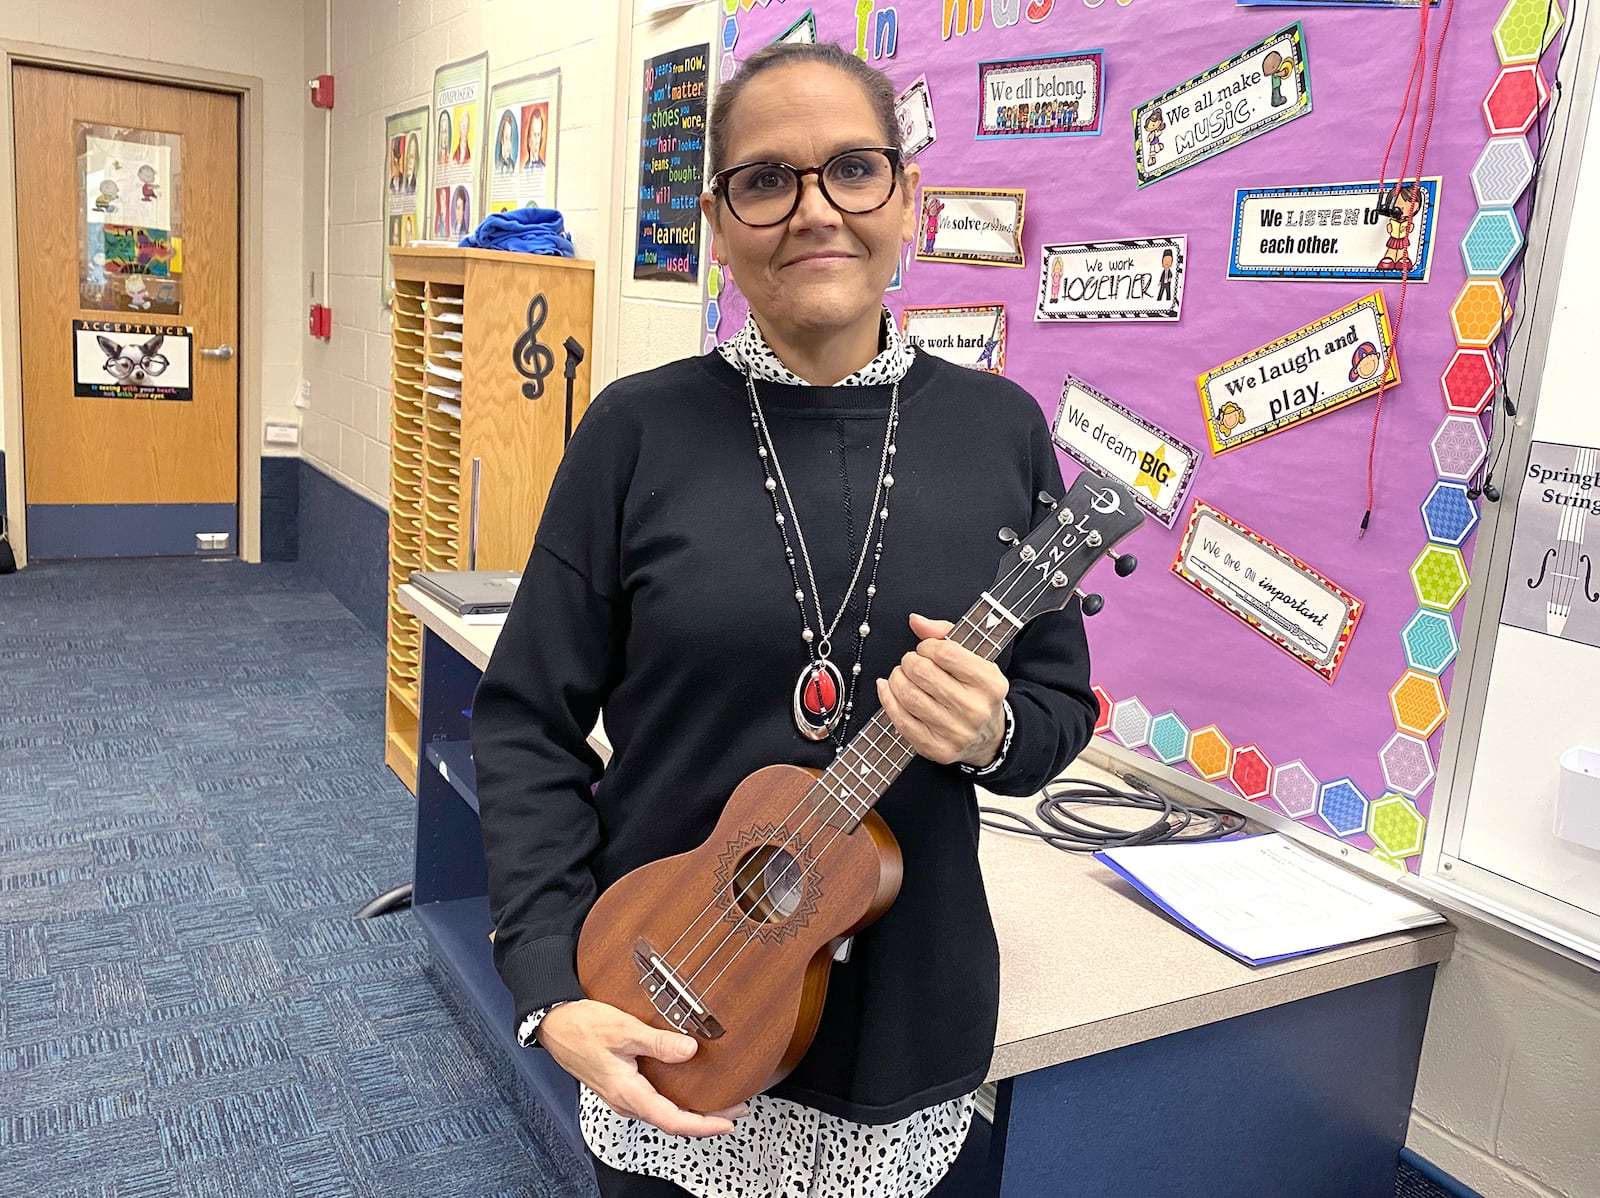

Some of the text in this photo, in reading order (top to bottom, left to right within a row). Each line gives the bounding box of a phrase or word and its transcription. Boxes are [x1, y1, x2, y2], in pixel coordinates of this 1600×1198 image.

[853, 0, 897, 60] In
[644, 67, 654, 92] 30
[654, 62, 673, 80] years
[684, 55, 706, 73] now,
[439, 85, 475, 106] COMPOSERS
[653, 83, 671, 102] won't
[671, 80, 705, 101] matter
[990, 75, 1087, 101] We all belong.
[1165, 70, 1261, 126] We all make
[651, 107, 680, 129] shoes
[682, 114, 705, 129] wore,
[657, 134, 677, 153] hair
[650, 157, 669, 174] jeans
[668, 165, 701, 183] bought.
[655, 186, 671, 204] will
[671, 195, 698, 209] matter
[939, 215, 951, 229] We
[951, 217, 982, 230] solve
[1260, 209, 1283, 227] We
[1363, 207, 1379, 225] to
[652, 221, 696, 244] learned
[1260, 236, 1339, 254] each other.
[666, 253, 690, 273] used
[1085, 258, 1135, 273] We work
[82, 321, 184, 336] ACCEPTANCE
[909, 335, 988, 348] We work hard.
[1225, 325, 1359, 397] We laugh and
[1269, 381, 1325, 421] play.
[1068, 405, 1171, 488] We dream BIG.
[1034, 514, 1090, 581] LUNA
[1203, 537, 1329, 630] We are all important.
